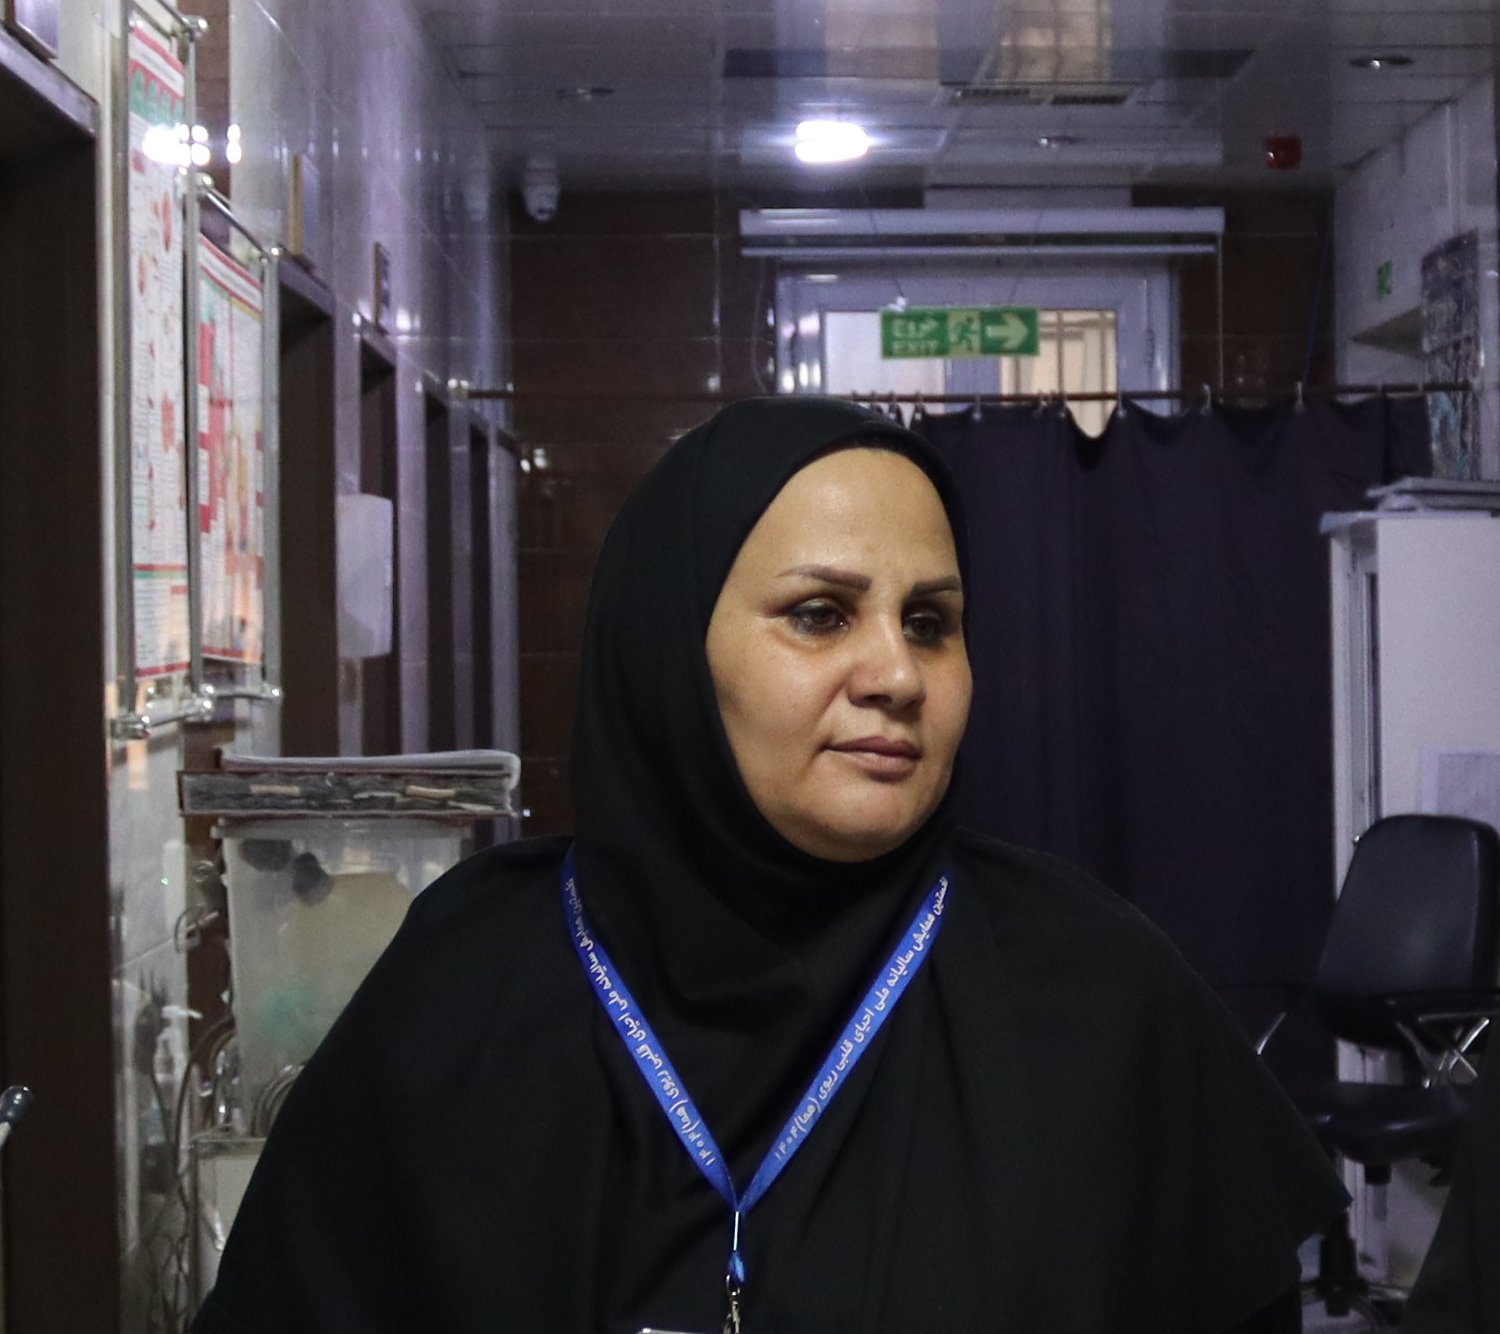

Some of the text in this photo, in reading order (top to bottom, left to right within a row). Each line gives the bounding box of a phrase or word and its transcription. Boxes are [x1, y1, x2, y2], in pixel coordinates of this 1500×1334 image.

[892, 317, 938, 339] خروج
[893, 341, 938, 356] EXIT
[913, 913, 936, 951] همایش
[886, 950, 915, 987] سالیانه
[575, 915, 594, 951] همایش
[588, 951, 612, 990] سالیانه
[608, 990, 628, 1011] ملی
[618, 1012, 646, 1042] احیای
[636, 1044, 663, 1069] قلبی
[657, 1070, 680, 1099] ریوی
[875, 987, 890, 1011] ملی
[854, 1007, 875, 1043] احیای
[836, 1039, 854, 1071] قلبی
[818, 1070, 838, 1100] ریوی
